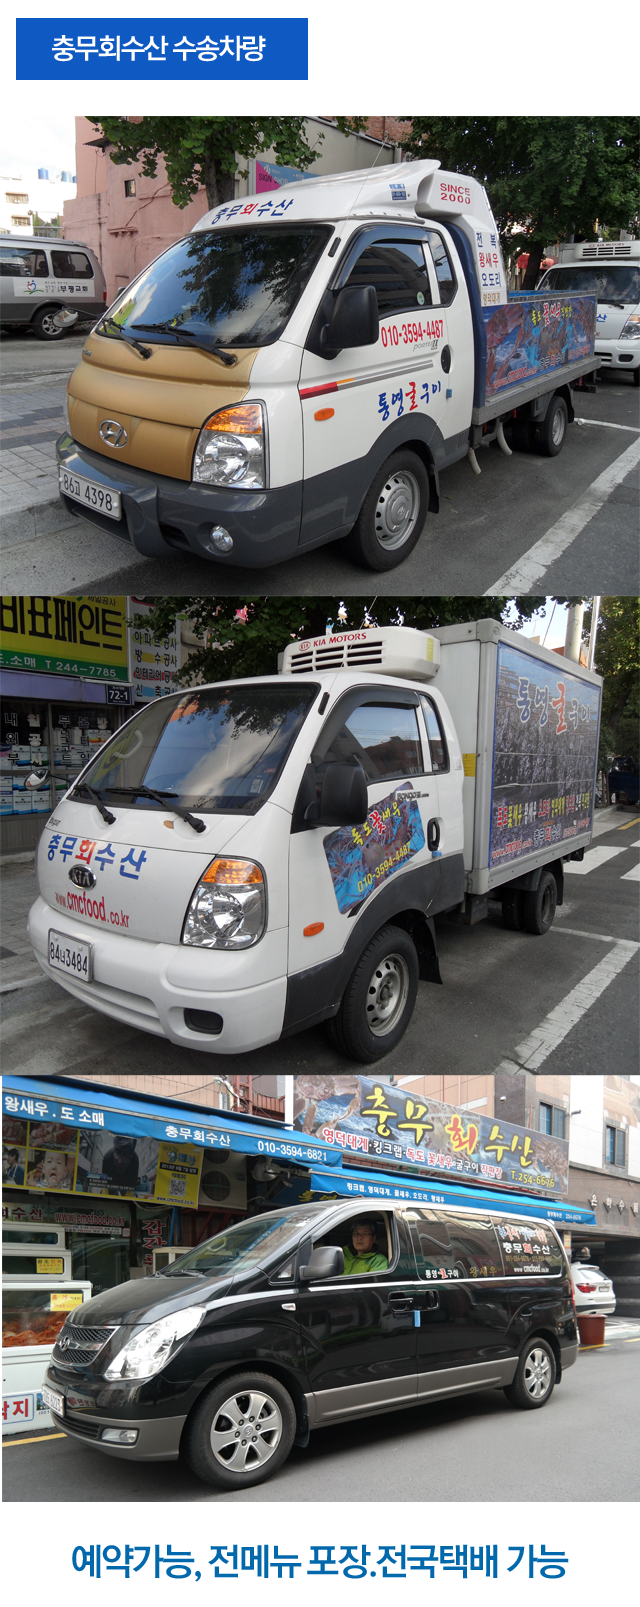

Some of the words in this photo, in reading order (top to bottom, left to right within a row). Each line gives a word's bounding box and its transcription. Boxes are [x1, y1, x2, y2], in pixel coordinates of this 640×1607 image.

[440, 183, 470, 196] SINCE
[440, 193, 471, 204] 2000
[211, 199, 294, 225] 충무회수산
[479, 252, 499, 268] 왕새우
[482, 272, 501, 287] 오도리
[60, 285, 88, 293] 부평교회
[381, 319, 443, 347] 010-3594-4487
[63, 473, 81, 496] 86고
[85, 485, 112, 512] 4398
[313, 639, 326, 647] KIA
[329, 632, 367, 644] MOTORS
[45, 660, 51, 669] T
[56, 661, 116, 677] 244-7785
[109, 690, 128, 700] 72-1
[47, 833, 147, 880] 충무회수산
[358, 841, 411, 892] 010-3594-4487
[71, 869, 91, 886] KIA
[5, 1096, 49, 1117] 왕새우
[78, 1110, 105, 1127] 소매
[164, 1125, 231, 1147] 충무회수산
[258, 1140, 327, 1161] 010-3594-6821
[511, 1170, 555, 1188] T.254-6676
[55, 1212, 126, 1226] www.cmcfood.co.kr
[503, 1242, 551, 1255] 충무회수산
[469, 1266, 497, 1278] 왕새우
